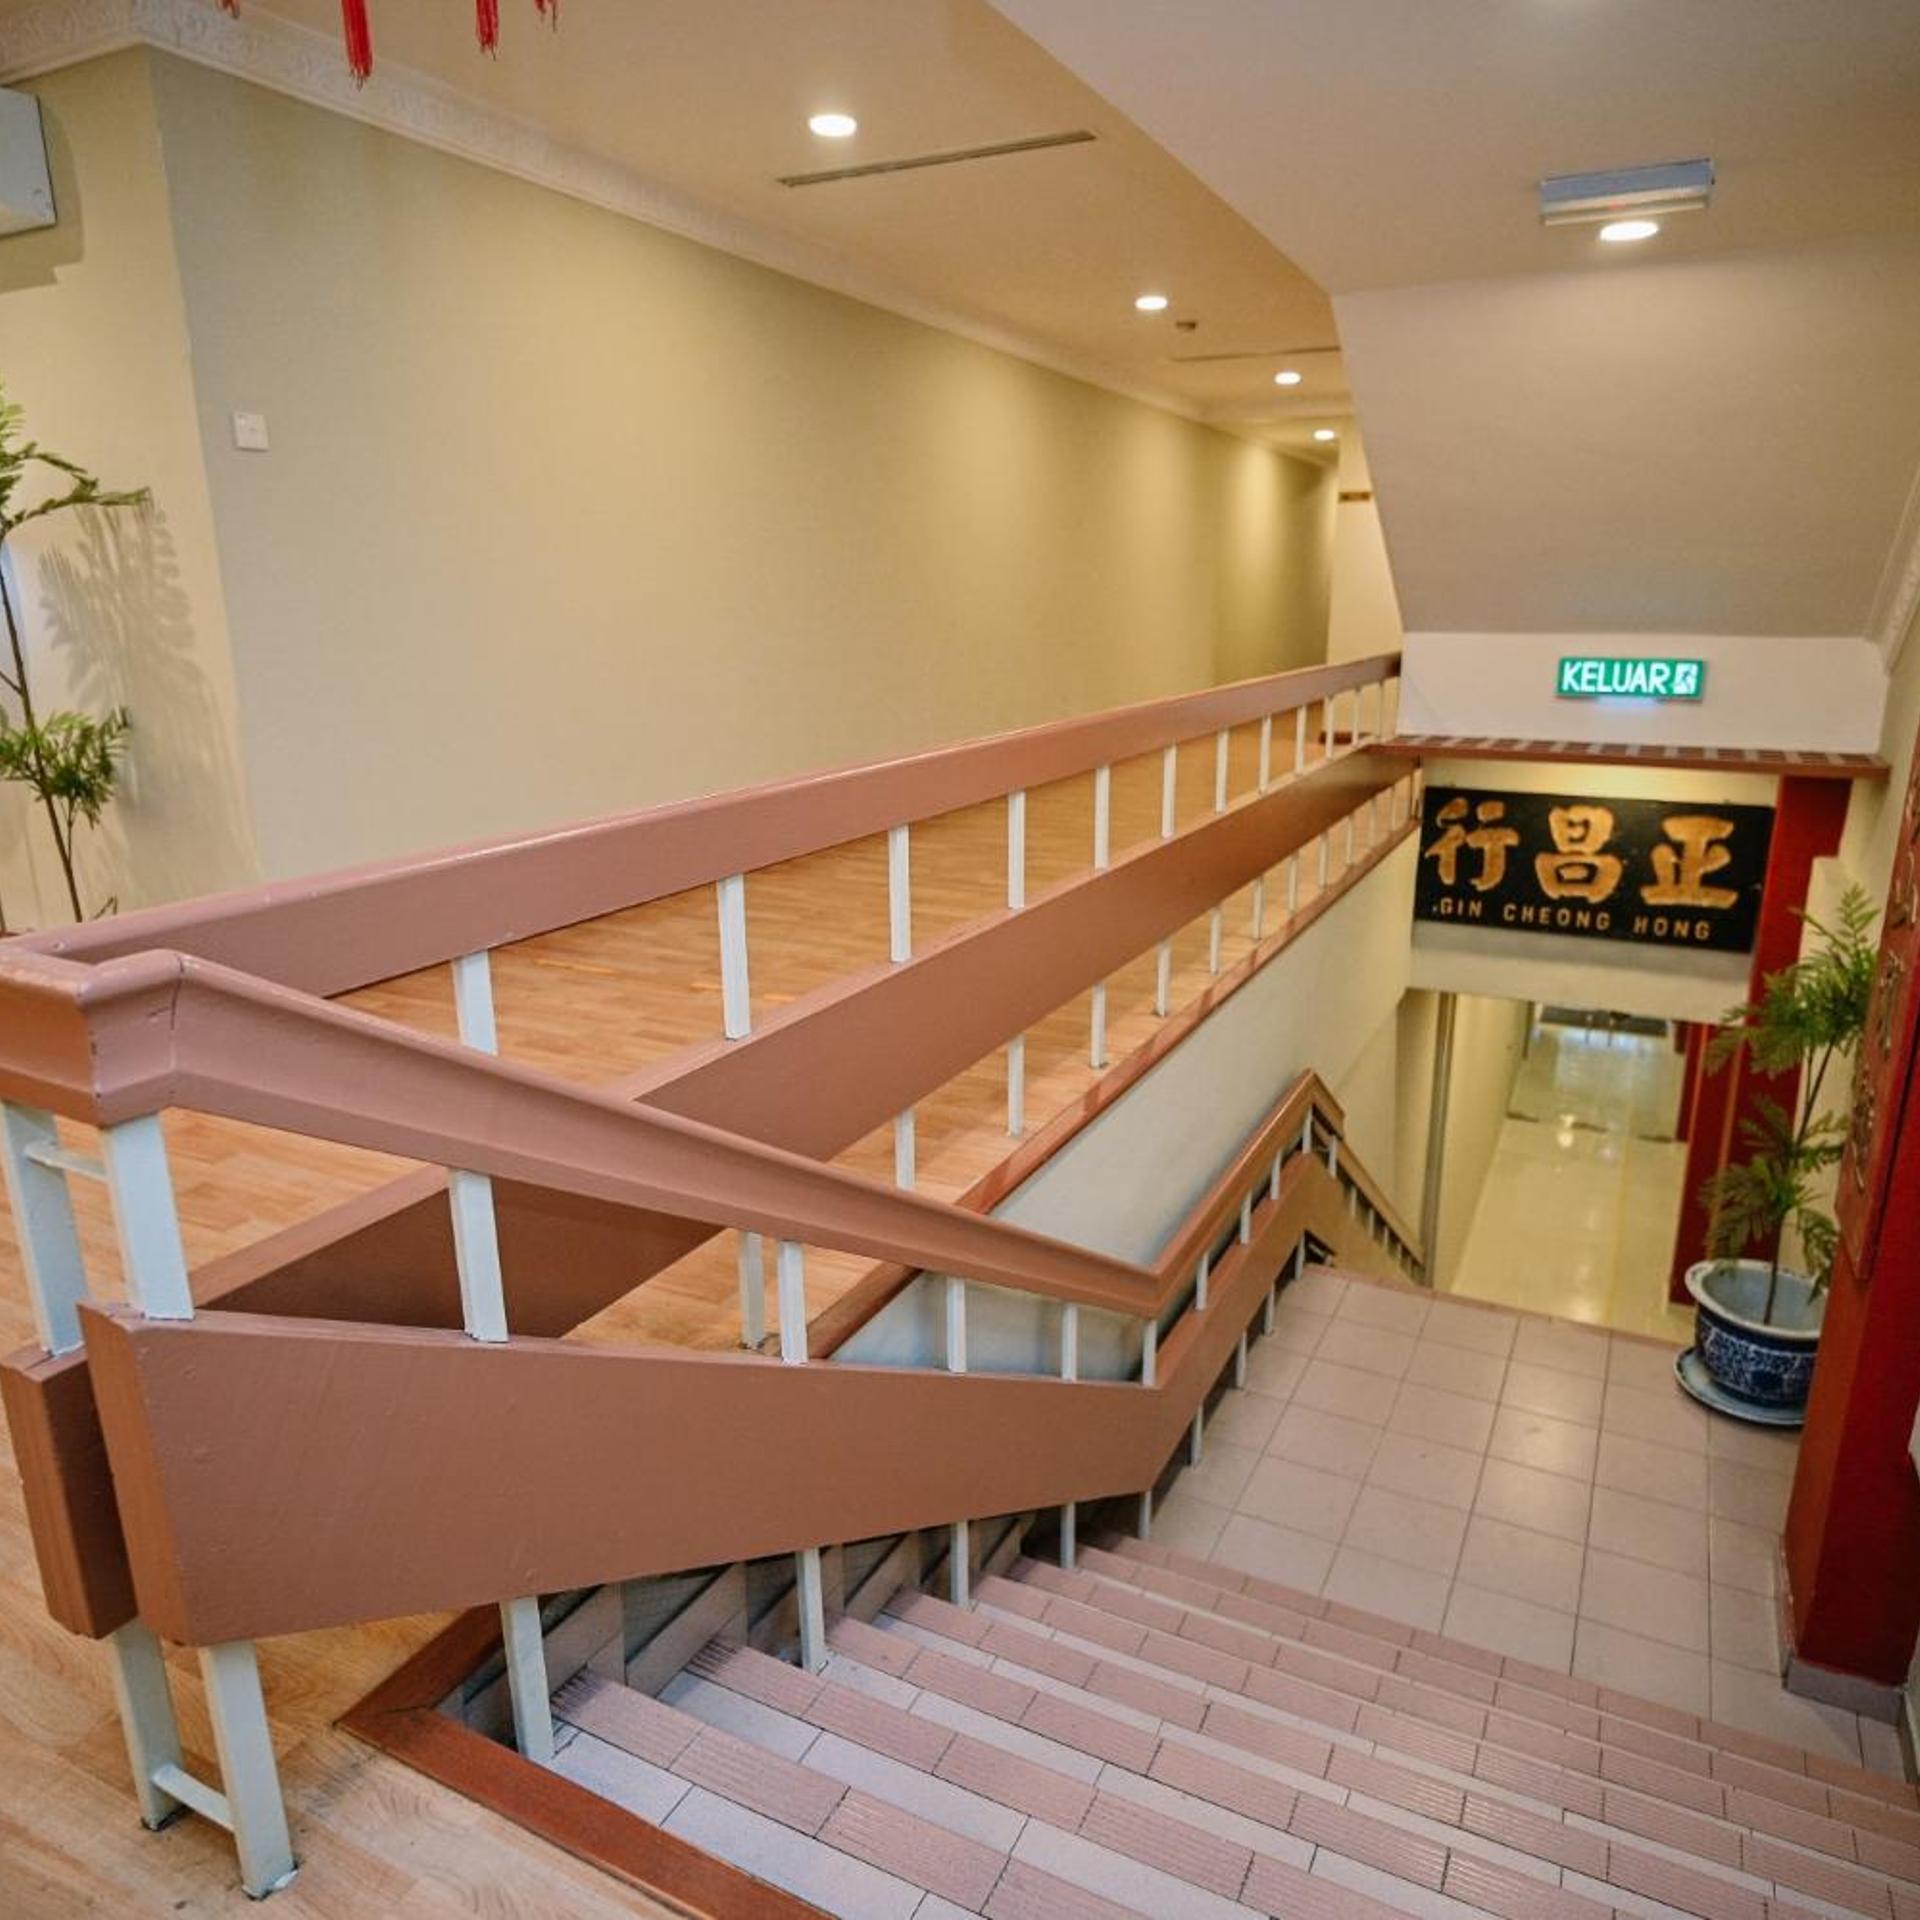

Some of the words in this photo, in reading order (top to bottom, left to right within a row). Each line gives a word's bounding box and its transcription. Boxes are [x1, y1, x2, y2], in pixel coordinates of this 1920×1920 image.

[1562, 661, 1670, 694] KELUAR
[1503, 903, 1610, 930] CHEONG
[1633, 915, 1710, 940] HONG
